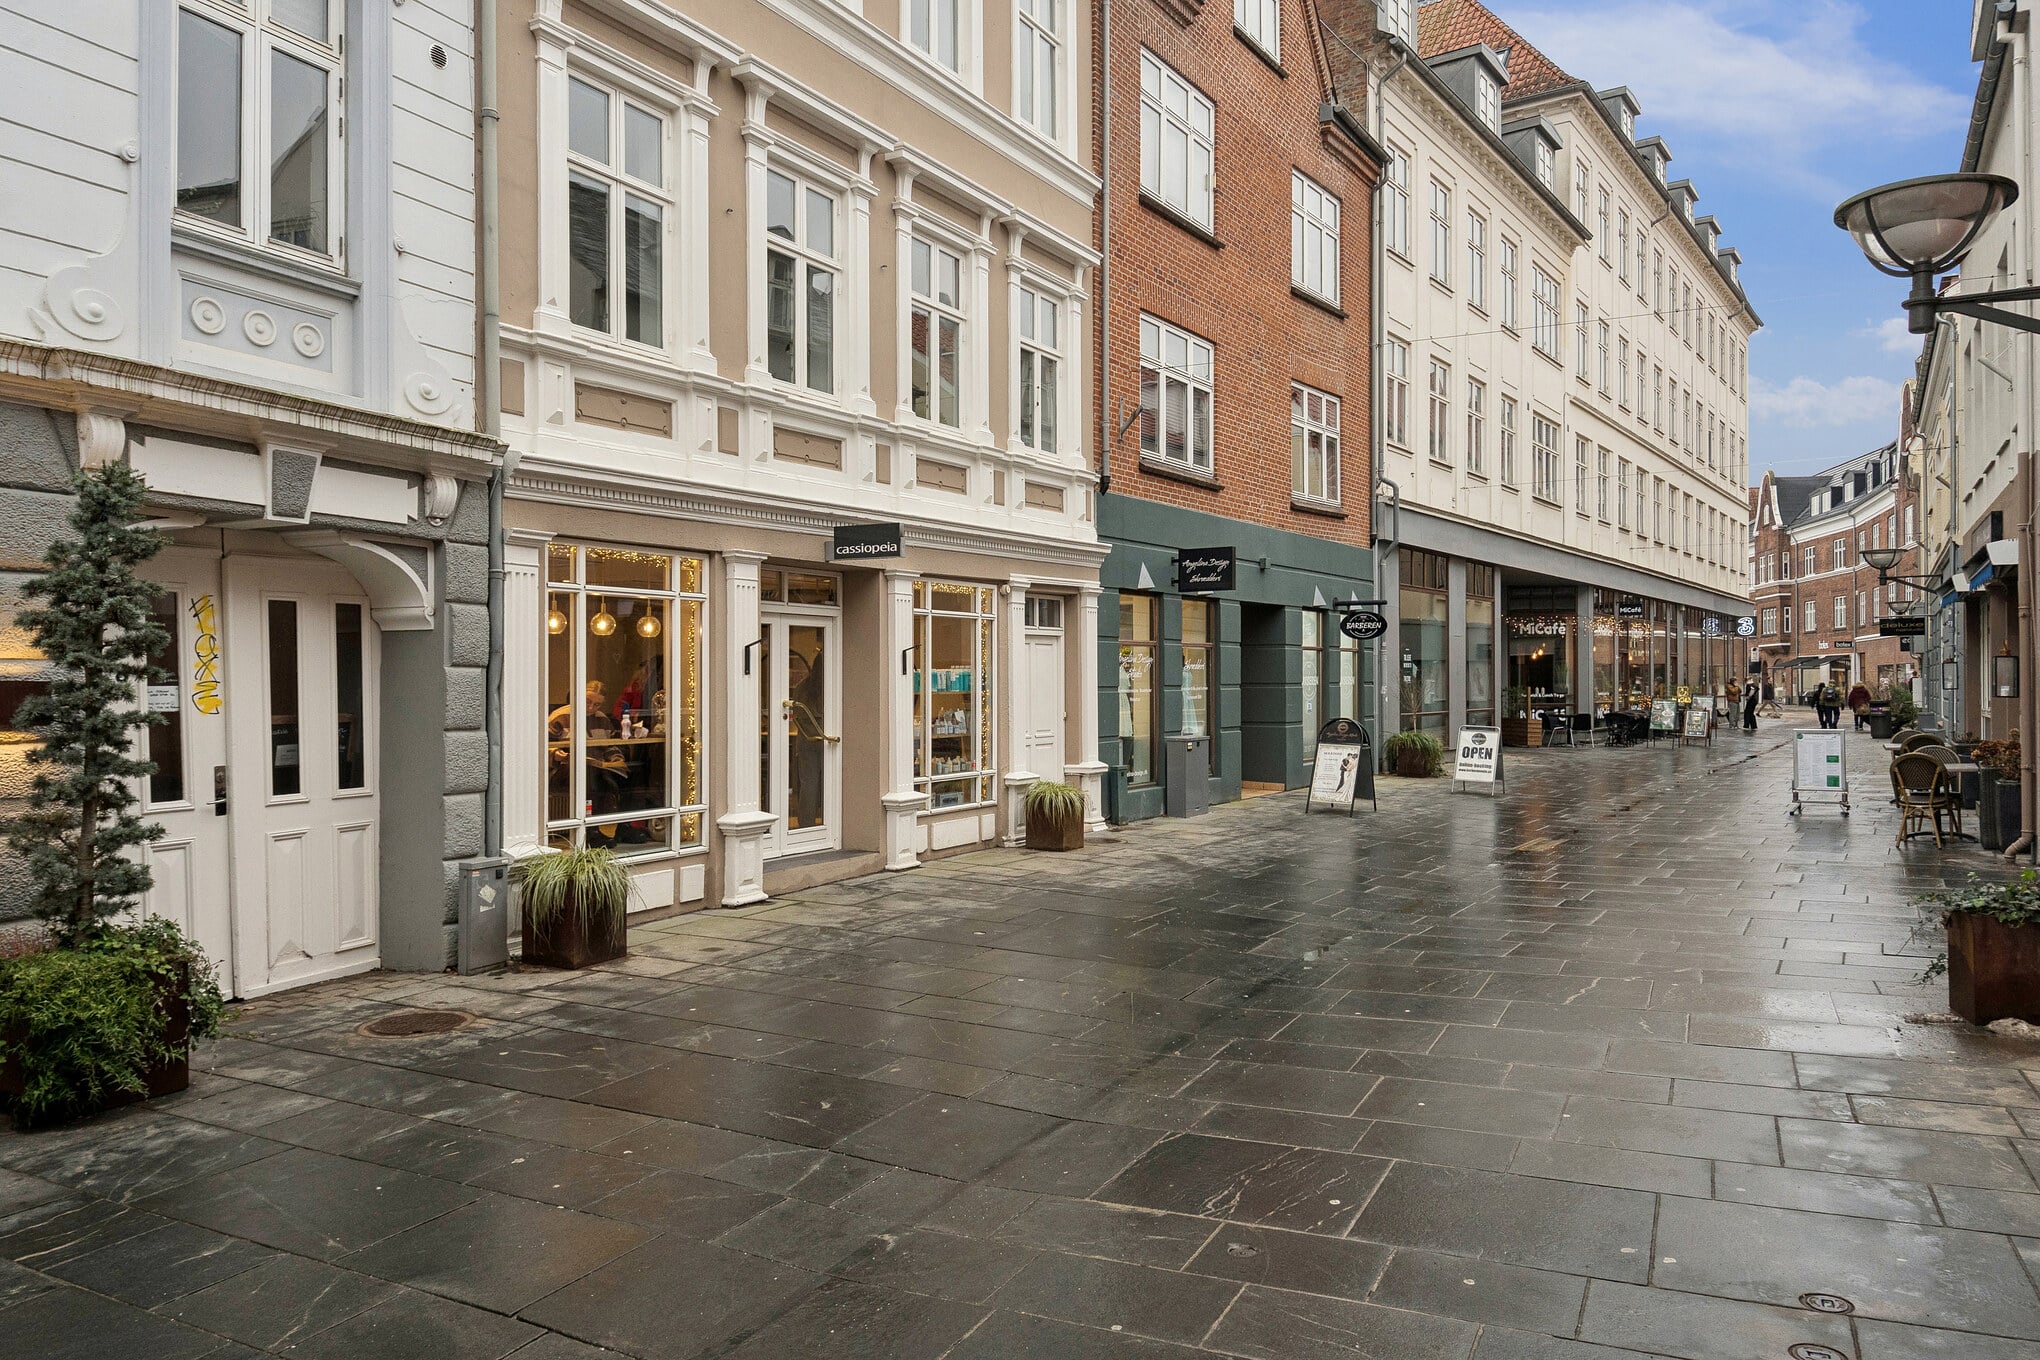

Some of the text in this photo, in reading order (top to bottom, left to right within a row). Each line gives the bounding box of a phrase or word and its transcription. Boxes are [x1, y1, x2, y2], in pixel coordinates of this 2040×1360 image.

[836, 541, 898, 555] cassiopeia
[1346, 621, 1382, 630] BARBEREN
[1519, 621, 1567, 635] MiCafé
[1737, 616, 1755, 636] 3
[1880, 622, 1925, 630] deluxe
[1462, 746, 1493, 760] OPEN
